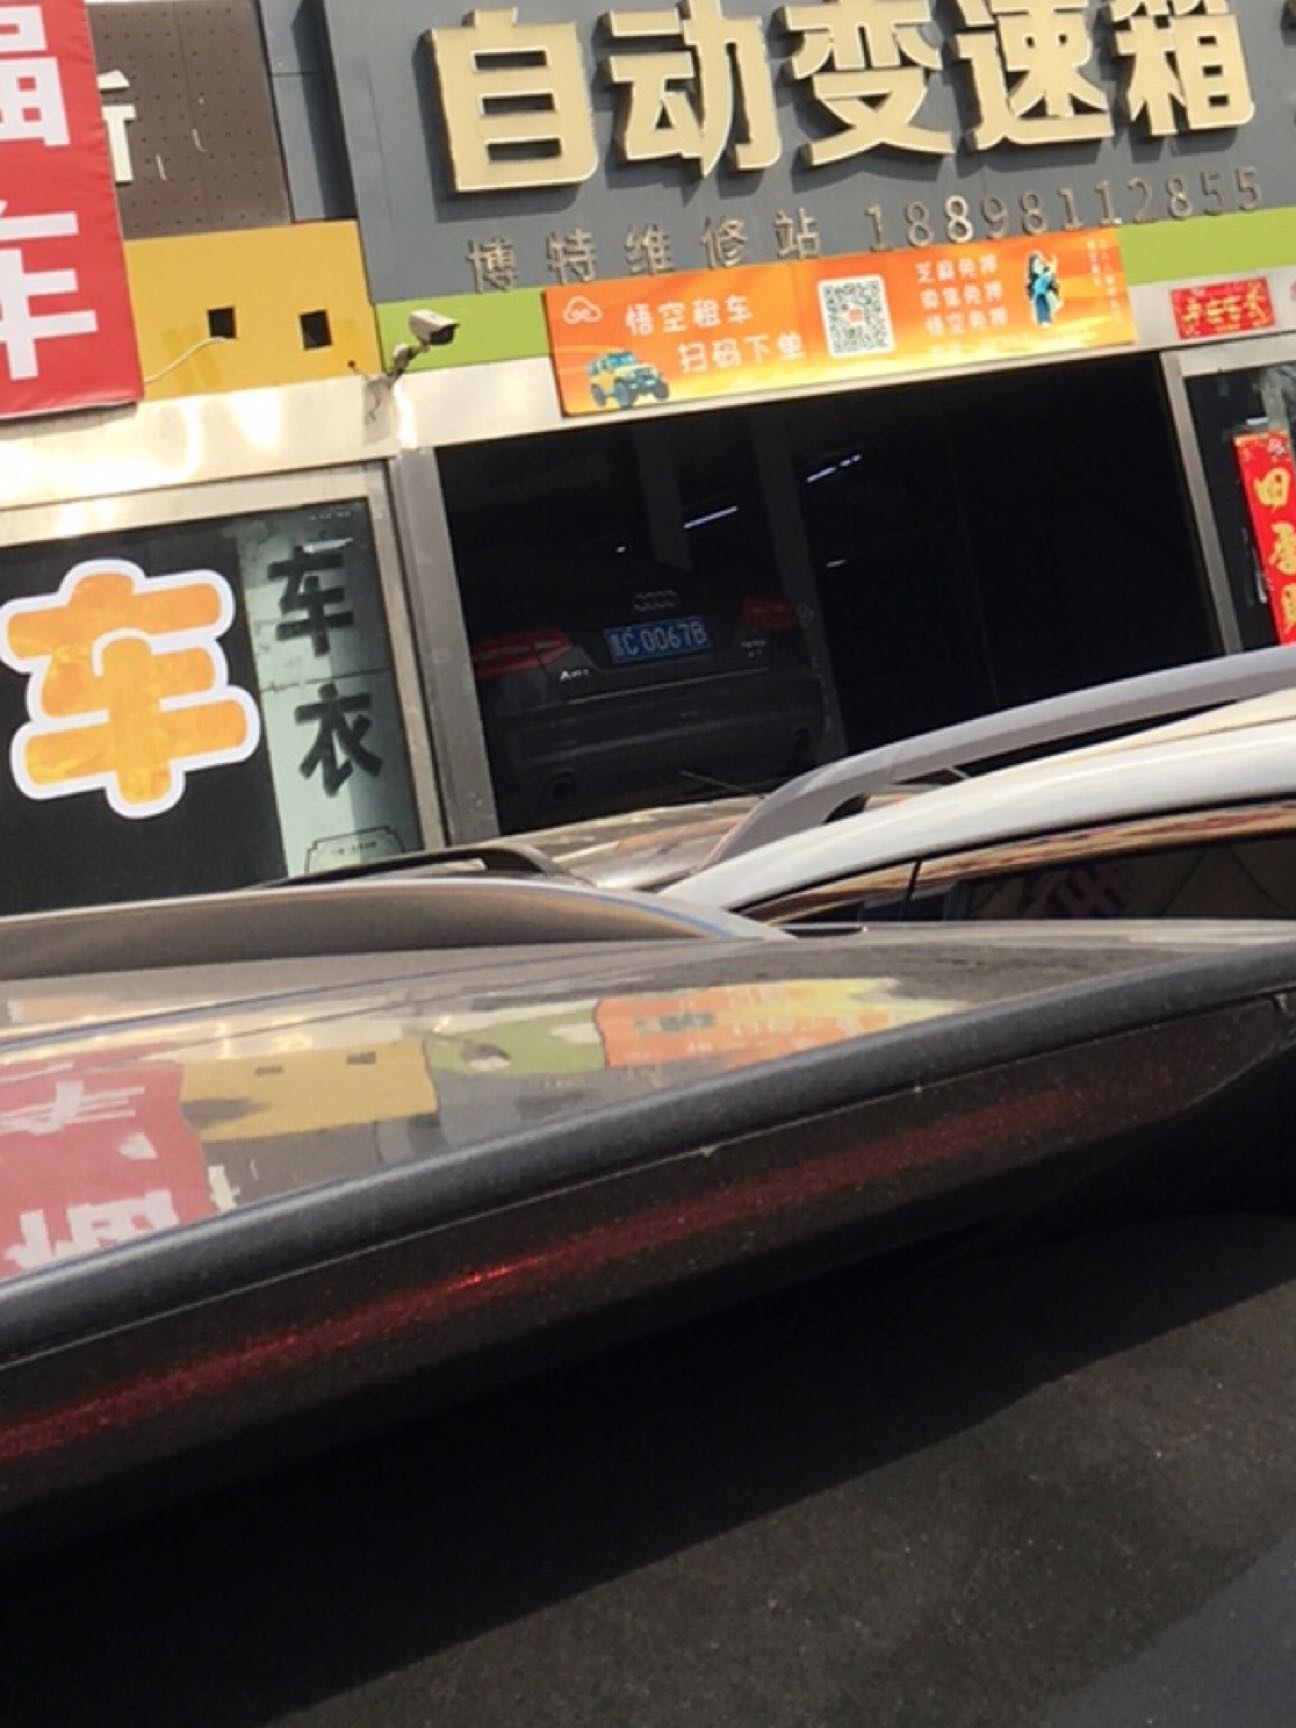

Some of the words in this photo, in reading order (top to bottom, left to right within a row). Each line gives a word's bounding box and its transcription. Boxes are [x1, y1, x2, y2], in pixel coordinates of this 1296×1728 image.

[865, 165, 1264, 253] 18898112855
[624, 295, 755, 337] 悟空租车
[677, 331, 805, 373] 扫码下单
[1, 559, 260, 820] 车
[267, 542, 384, 798] 车衣
